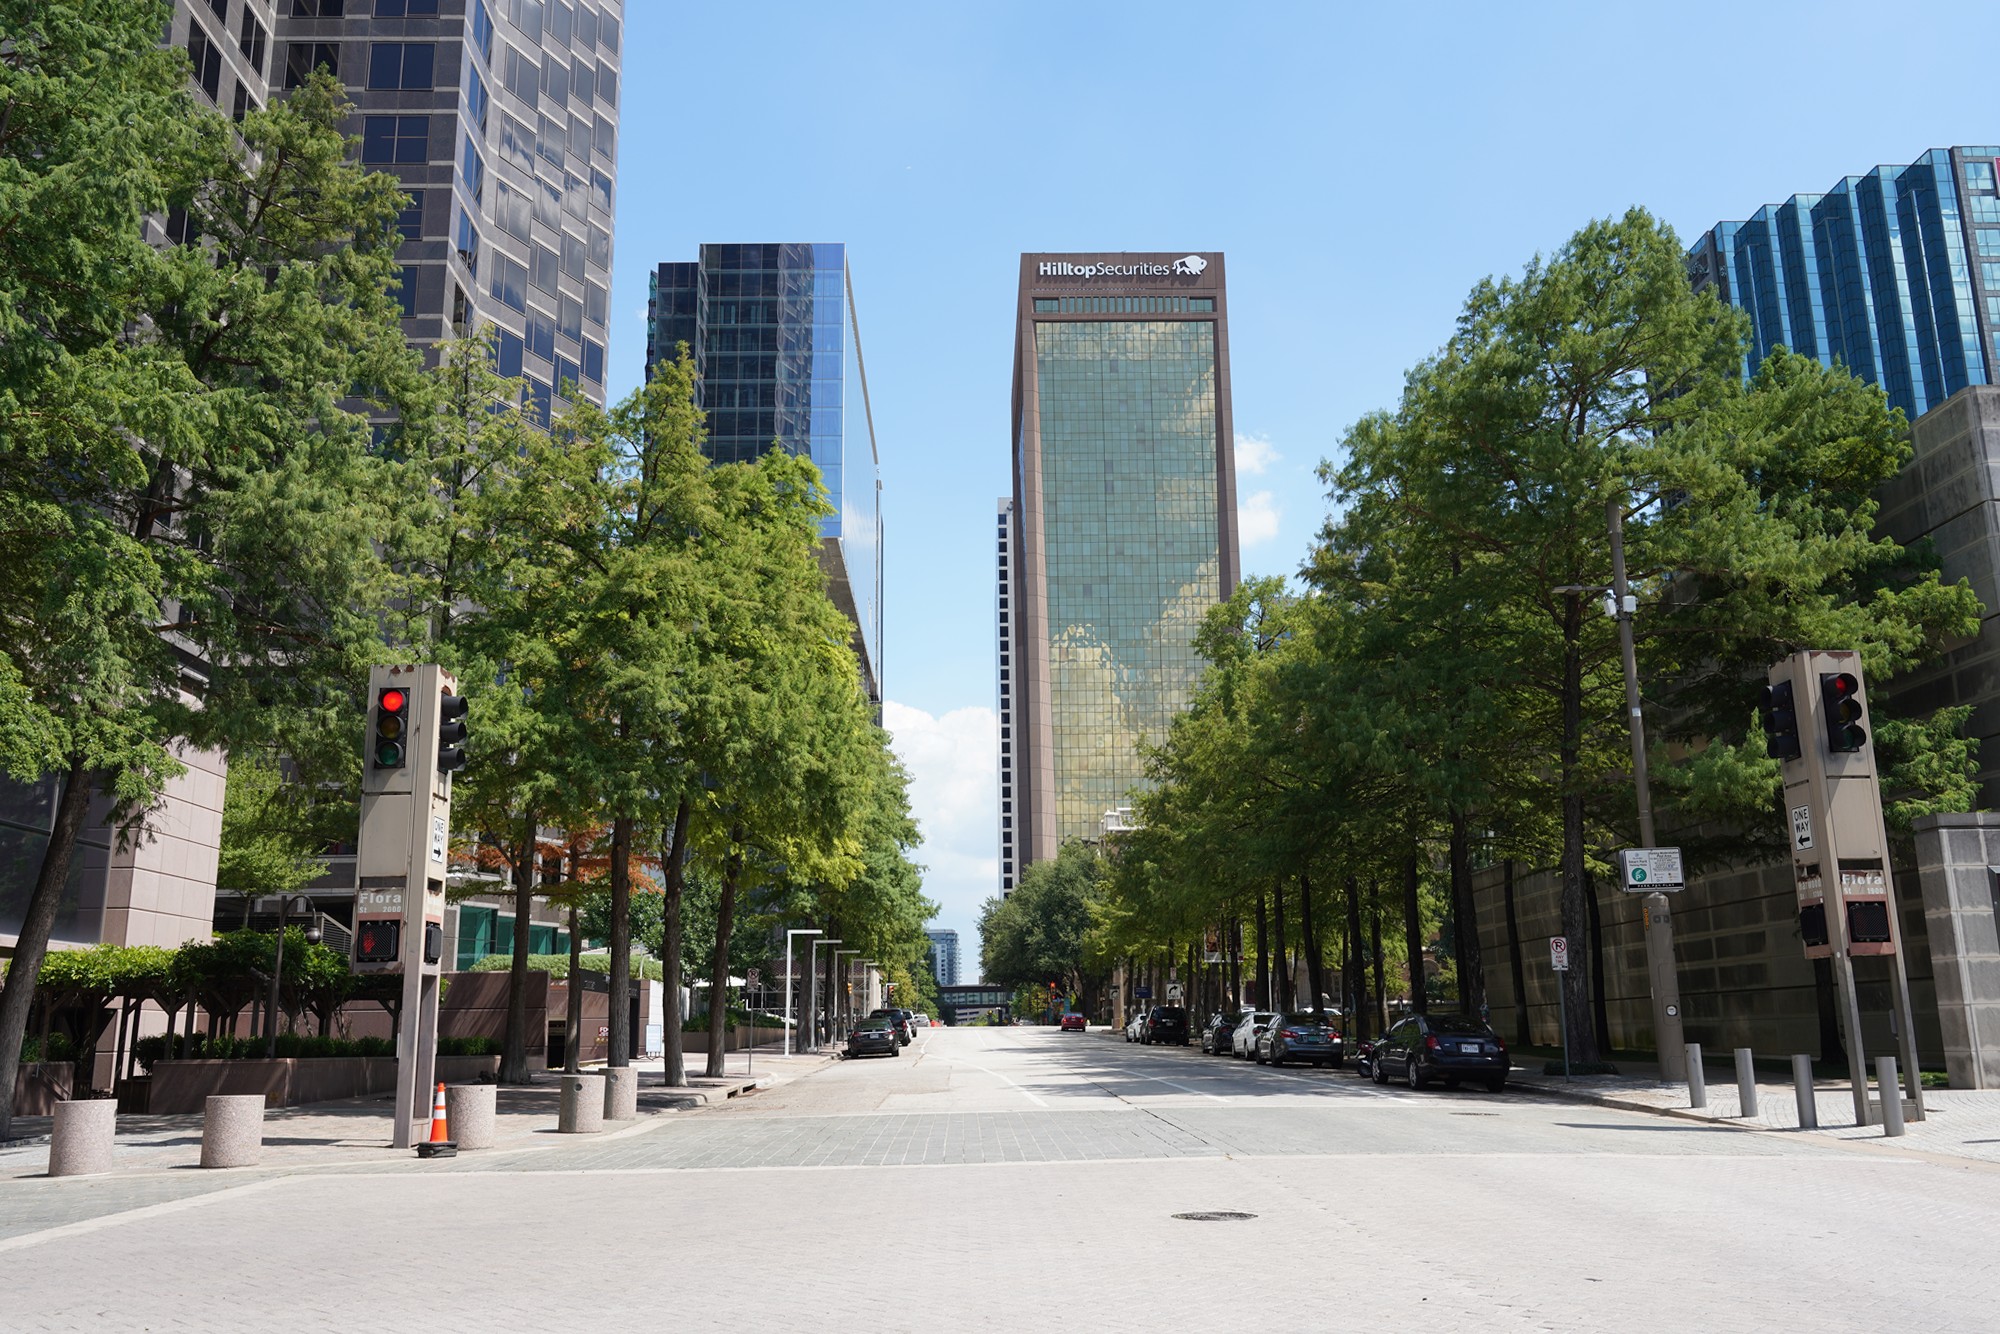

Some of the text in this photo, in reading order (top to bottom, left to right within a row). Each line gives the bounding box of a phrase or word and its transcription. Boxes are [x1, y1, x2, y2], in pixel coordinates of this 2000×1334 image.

[1039, 262, 1170, 278] HilltopSecurities
[1793, 808, 1808, 822] ONE
[1795, 820, 1809, 833] WAY
[1841, 873, 1883, 885] Flora
[360, 892, 402, 904] Flora
